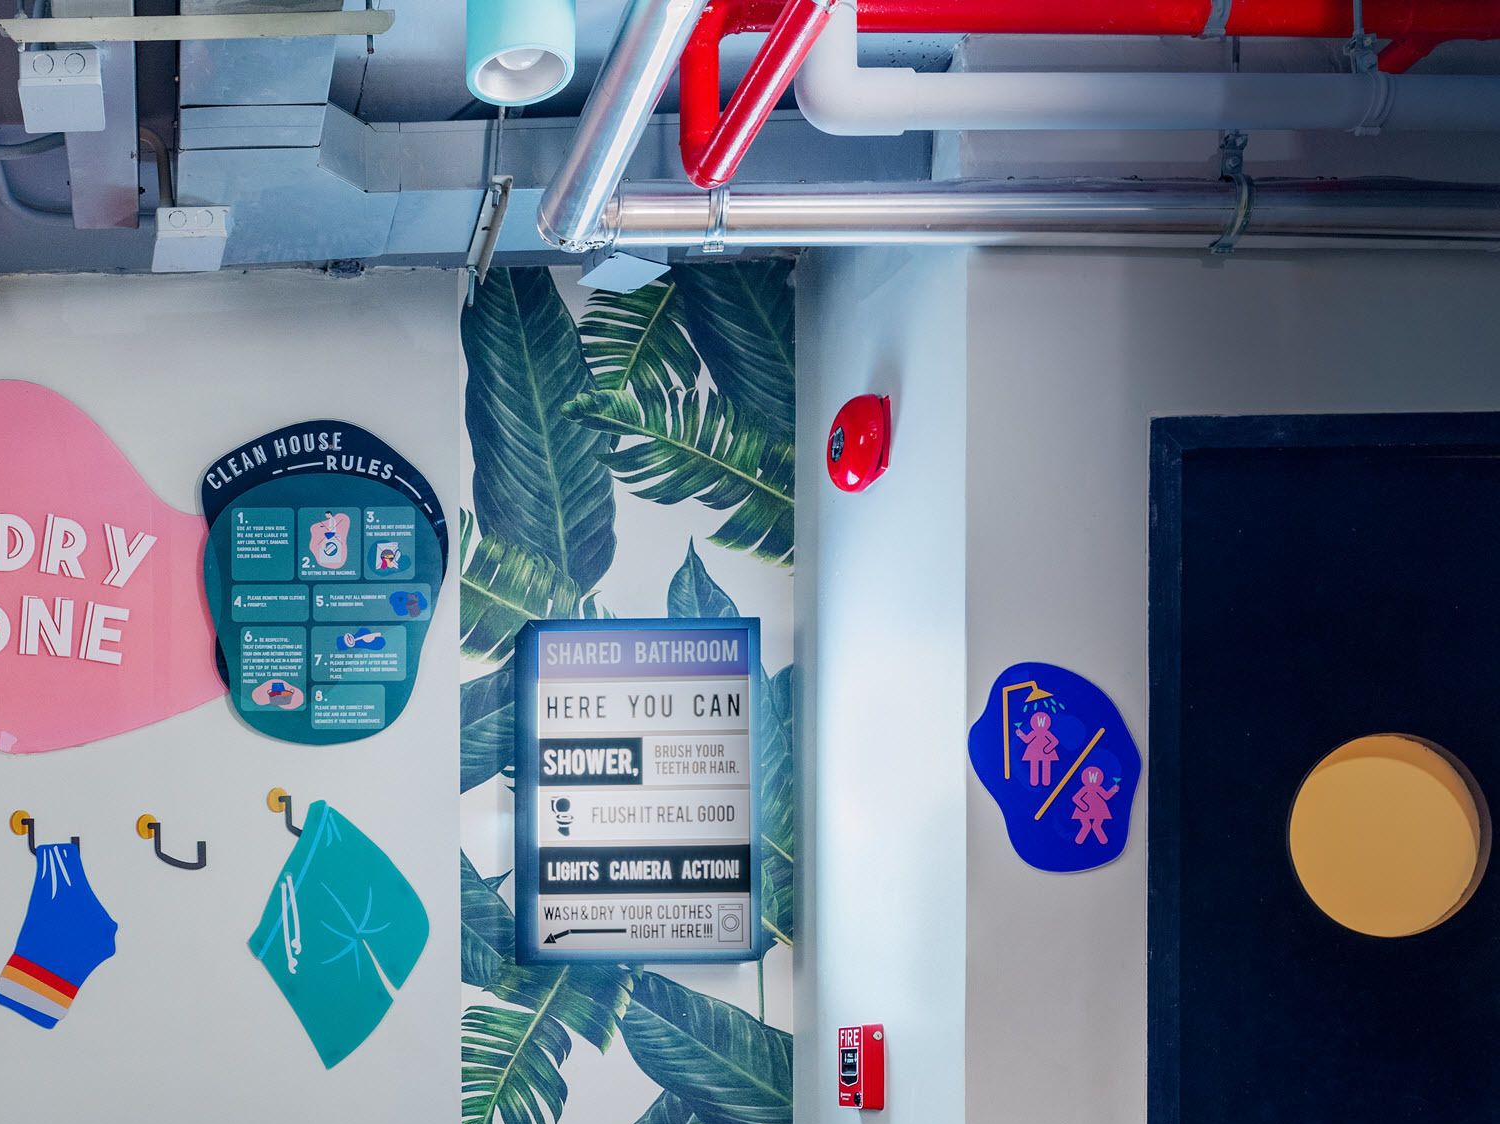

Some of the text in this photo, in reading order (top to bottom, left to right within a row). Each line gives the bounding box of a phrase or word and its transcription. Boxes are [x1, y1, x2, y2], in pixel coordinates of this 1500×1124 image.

[206, 432, 342, 490] CLEAN HOUSE
[326, 455, 394, 480] RULES
[546, 640, 739, 666] SHARED BATHROOM
[547, 694, 740, 719] HERE YOU CAN
[655, 744, 725, 758] BRUSH YOUR
[543, 748, 639, 777] SHOWER,
[655, 760, 740, 775] TEETH OR HAIR.
[591, 804, 735, 824] FLUSH IT REAL GOOD
[547, 860, 740, 881] LIGHTS CAMERA ACTION!
[622, 905, 652, 920] YOUR
[657, 904, 713, 920] CLOTHES
[630, 923, 713, 939] RIGHT HERE!!!
[840, 1029, 860, 1047] FIRE
